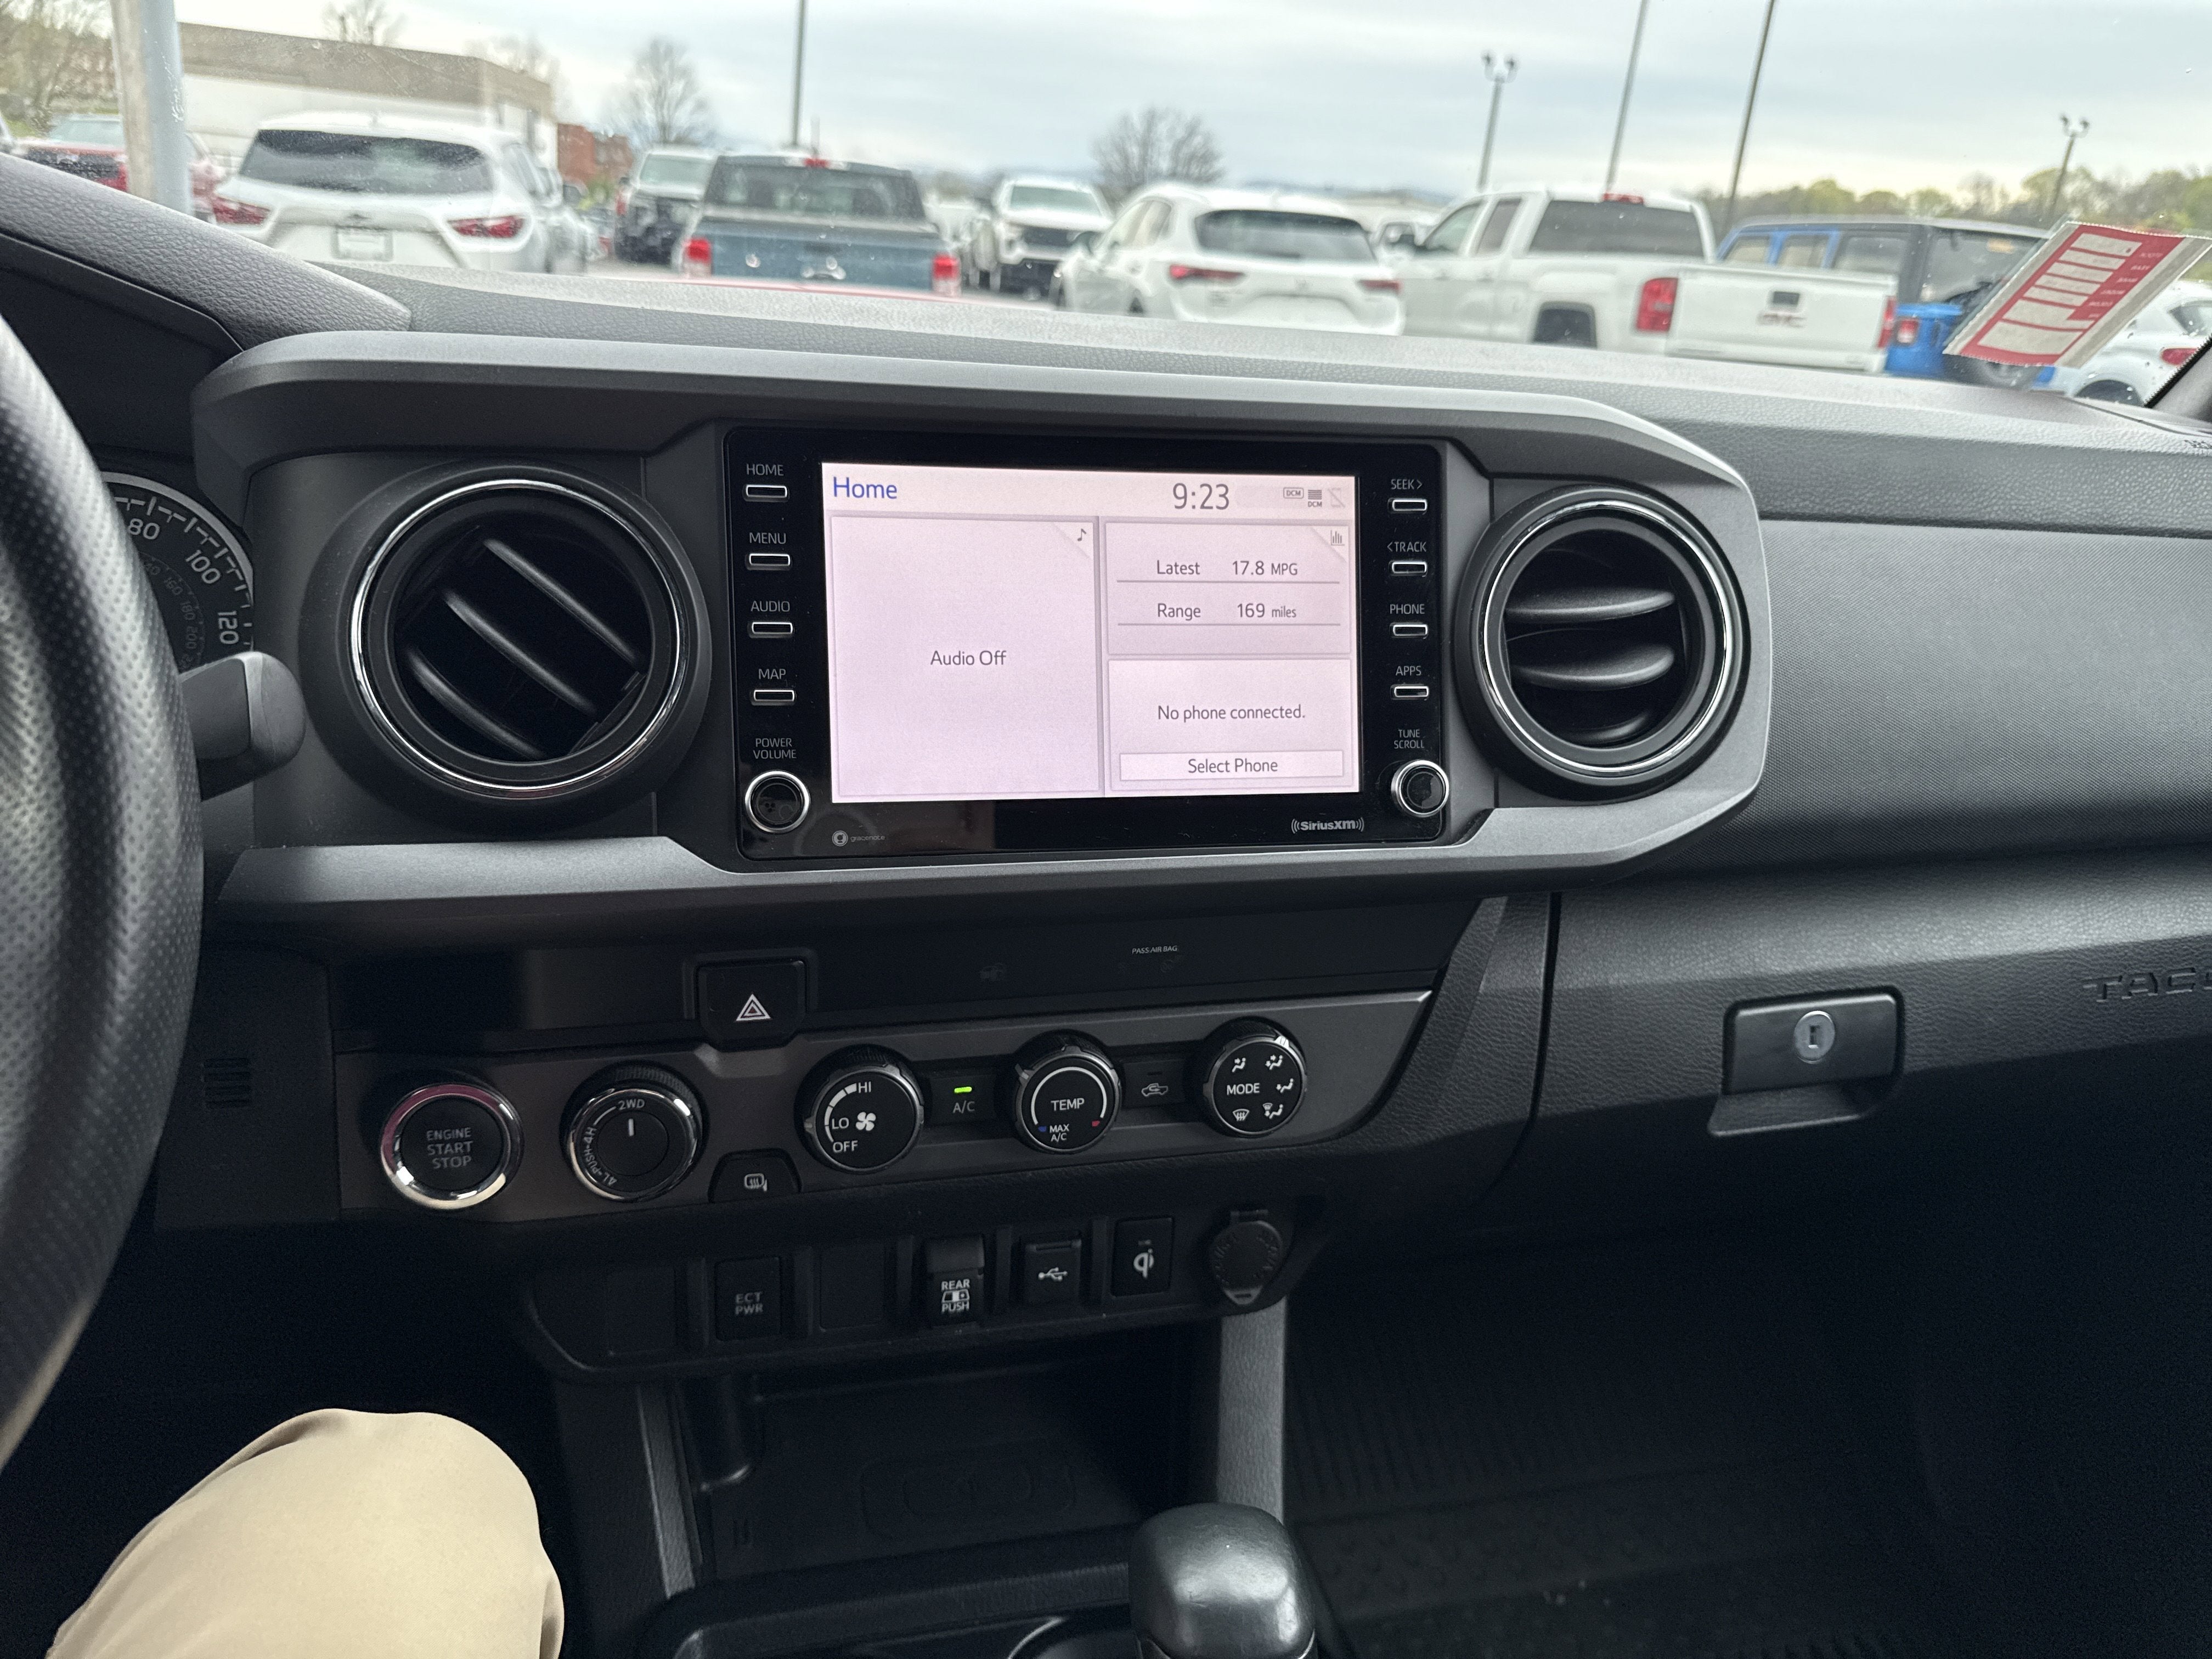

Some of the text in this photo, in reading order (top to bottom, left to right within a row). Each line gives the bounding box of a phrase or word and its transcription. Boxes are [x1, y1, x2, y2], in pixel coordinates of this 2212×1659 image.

[746, 464, 784, 476] HOME
[833, 476, 898, 499] Home
[1172, 482, 1229, 510] 9:23
[127, 517, 161, 541] 80
[749, 532, 786, 545] MENU
[185, 549, 221, 584] 100
[1156, 560, 1298, 576] Latest 17.8 MPG
[751, 600, 791, 612] AUDIO
[1158, 602, 1297, 621] Range 169 miles
[1390, 603, 1425, 614] PHONE
[218, 610, 239, 645] 120
[930, 650, 1007, 666] Audio Off
[758, 668, 786, 680] MAP
[1395, 665, 1422, 676] APPS
[1158, 703, 1306, 723] No phone connected.
[1398, 729, 1420, 738] TUNE
[755, 737, 792, 748] POWER
[1393, 740, 1425, 749] SCROLL
[753, 749, 797, 759] VOLUME
[1188, 758, 1278, 774] Select Phone
[858, 1081, 872, 1093] HI
[1227, 1082, 1260, 1095] MODE
[618, 1099, 645, 1110] 2WD
[952, 1100, 974, 1114] A/C
[1051, 1097, 1085, 1111] TEMP
[832, 1117, 849, 1130] LO
[1049, 1124, 1069, 1135] MAX
[426, 1127, 472, 1142] ENGINE
[1051, 1132, 1066, 1142] A/C
[426, 1141, 473, 1155] START
[832, 1140, 859, 1153] OFF
[431, 1155, 472, 1169] STOP
[941, 1278, 970, 1290] REAR
[735, 1291, 762, 1304] ECT
[735, 1304, 764, 1315] PWR
[941, 1301, 970, 1312] PUSH
